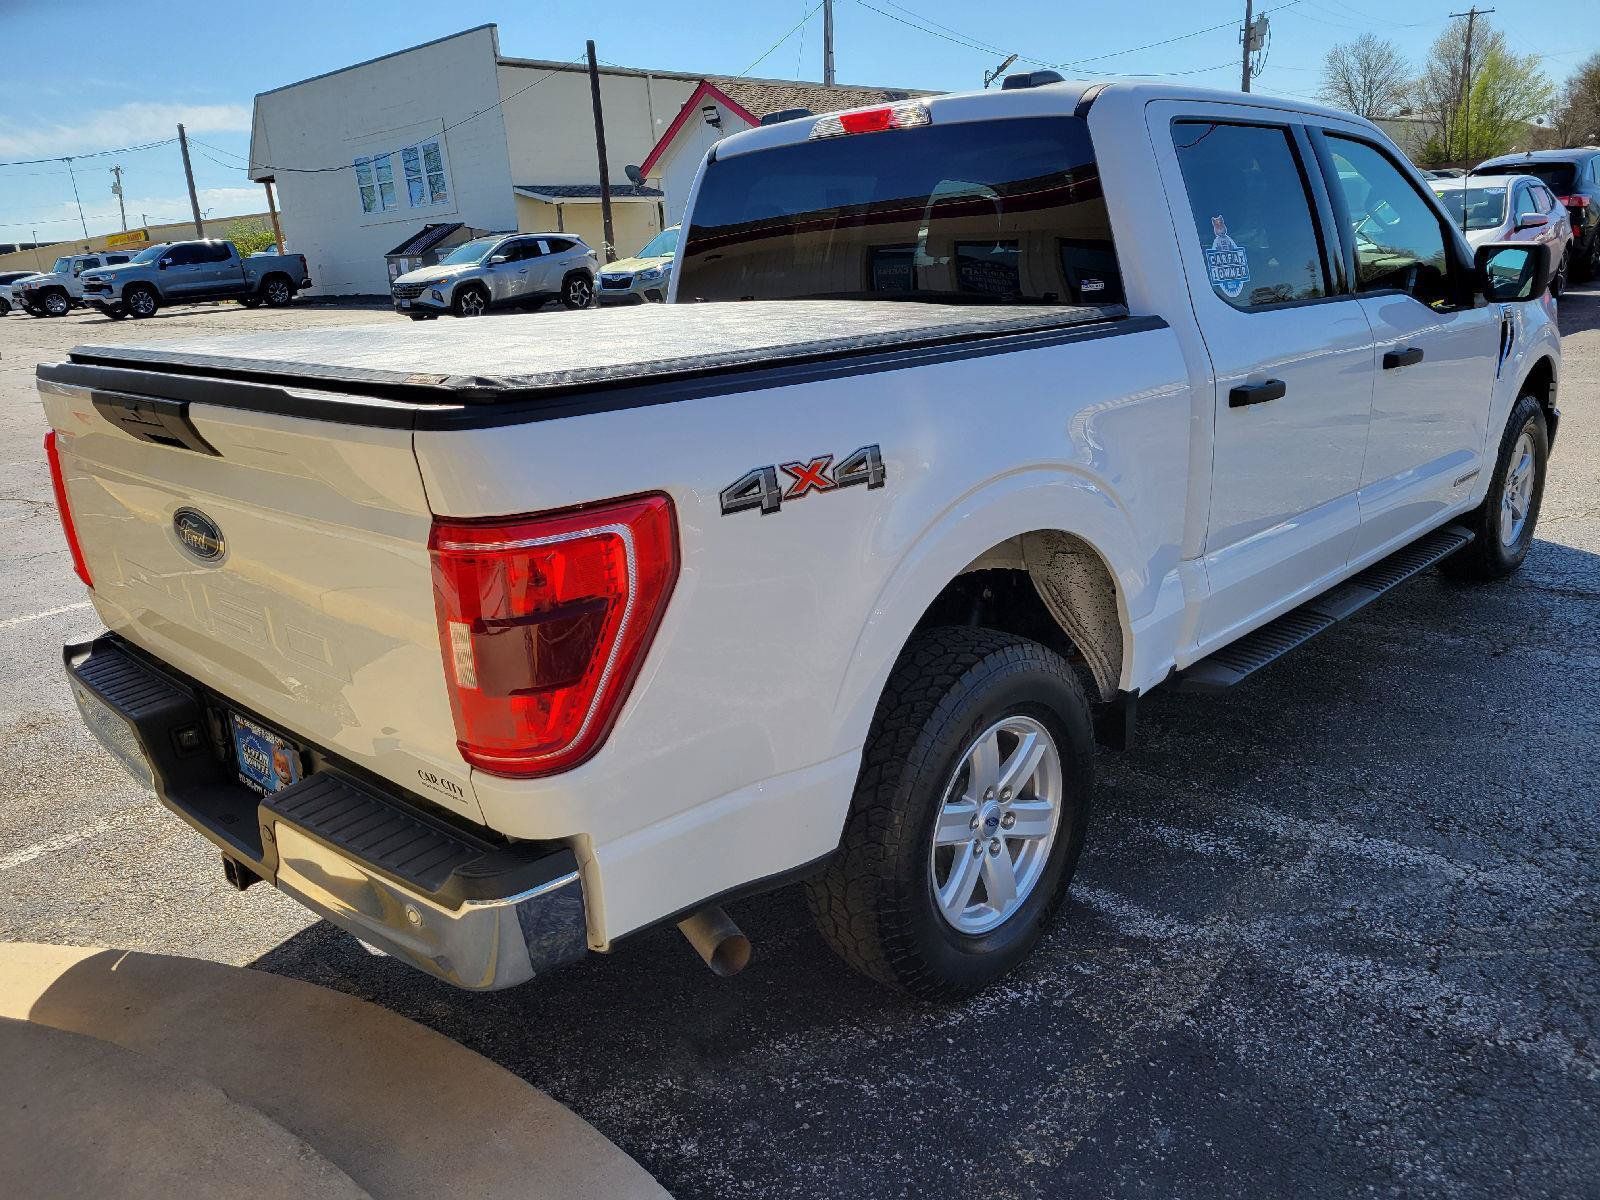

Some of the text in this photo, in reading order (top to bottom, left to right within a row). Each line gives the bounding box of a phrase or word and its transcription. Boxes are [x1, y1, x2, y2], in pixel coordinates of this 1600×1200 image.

[1210, 253, 1247, 266] CARFAX
[177, 517, 209, 551] Ford
[417, 769, 440, 786] CAR
[440, 778, 465, 798] CITY
